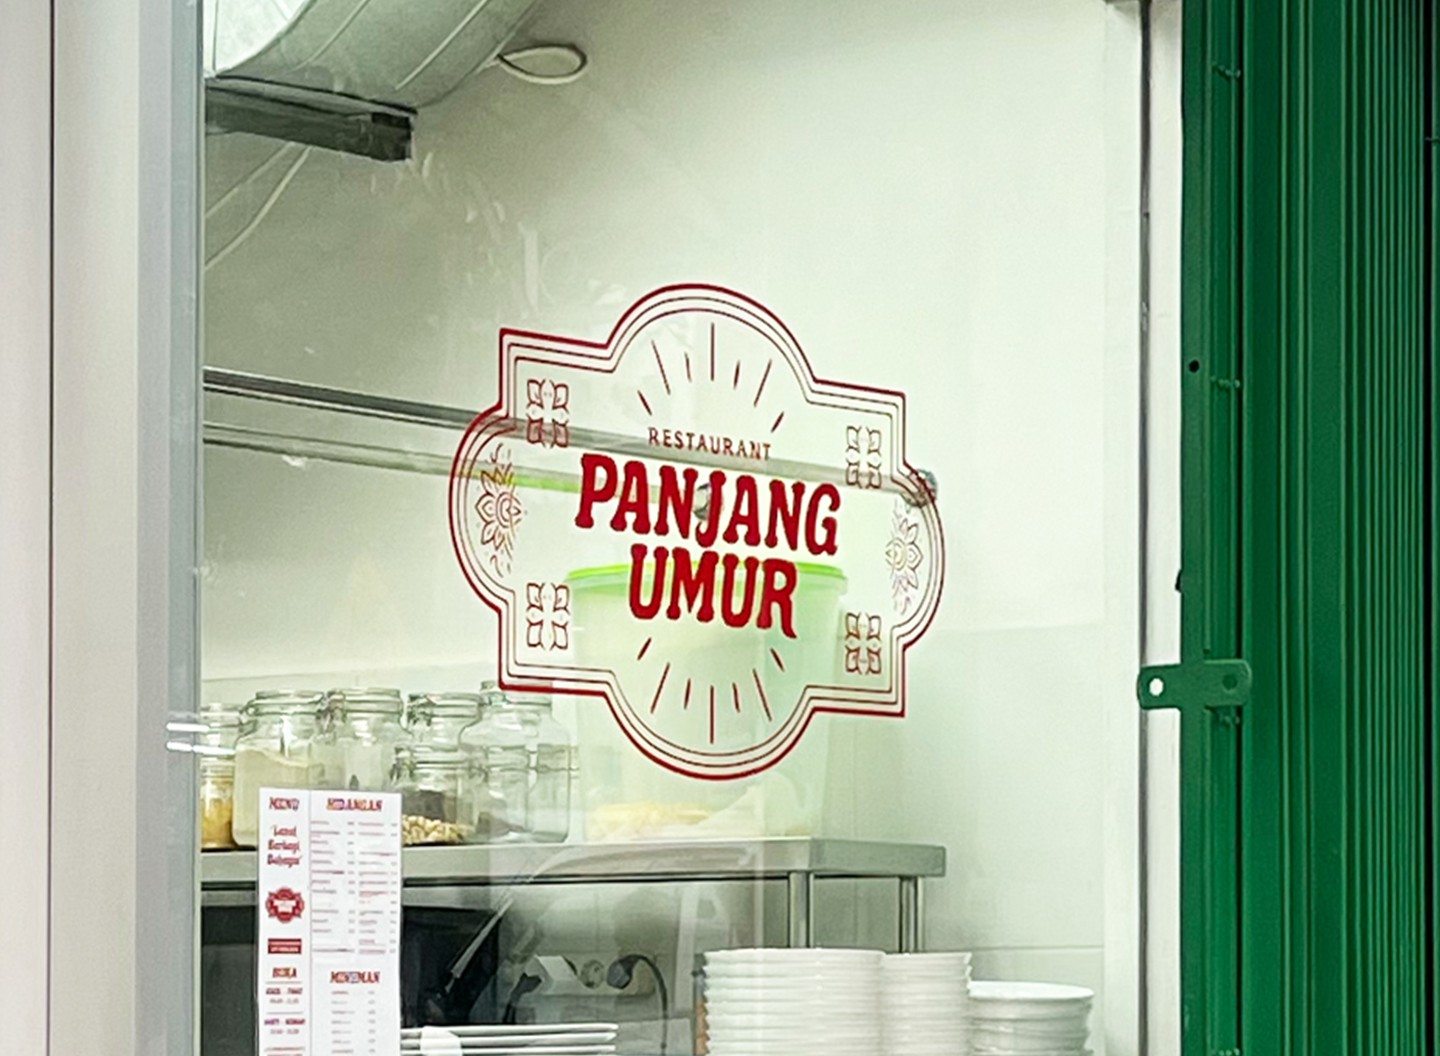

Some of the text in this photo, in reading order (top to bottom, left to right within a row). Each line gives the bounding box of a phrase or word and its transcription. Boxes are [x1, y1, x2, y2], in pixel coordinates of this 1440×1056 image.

[647, 426, 773, 461] RESTAURANT
[574, 452, 842, 556] PANJANG
[628, 543, 798, 640] UMUR
